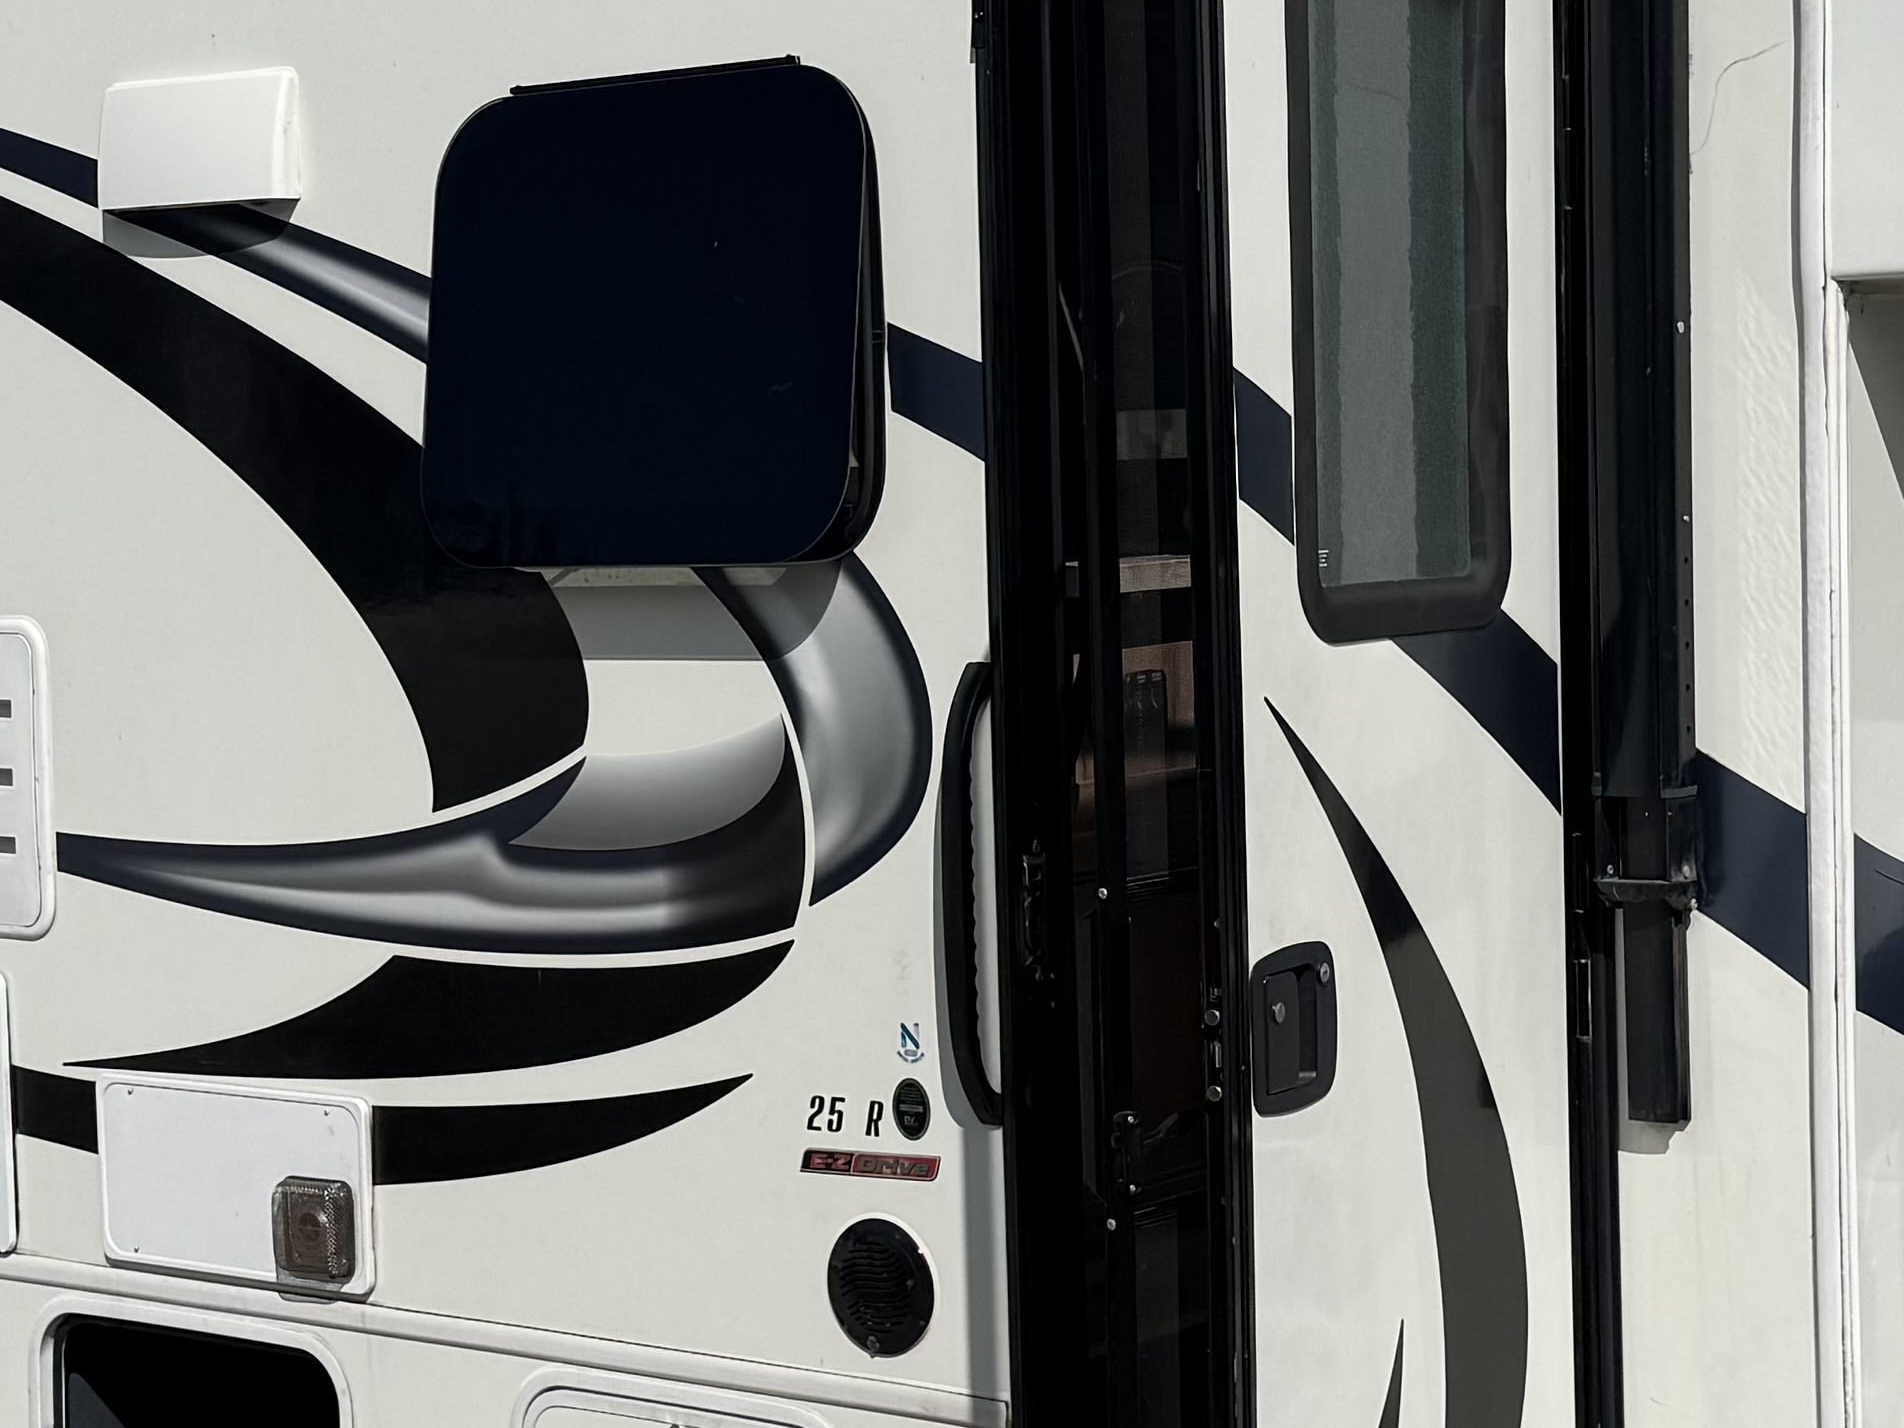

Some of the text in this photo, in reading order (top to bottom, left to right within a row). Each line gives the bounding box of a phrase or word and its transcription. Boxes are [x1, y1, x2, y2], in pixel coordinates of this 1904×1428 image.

[806, 1095, 885, 1138] 25 R
[858, 1157, 931, 1177] Drive
